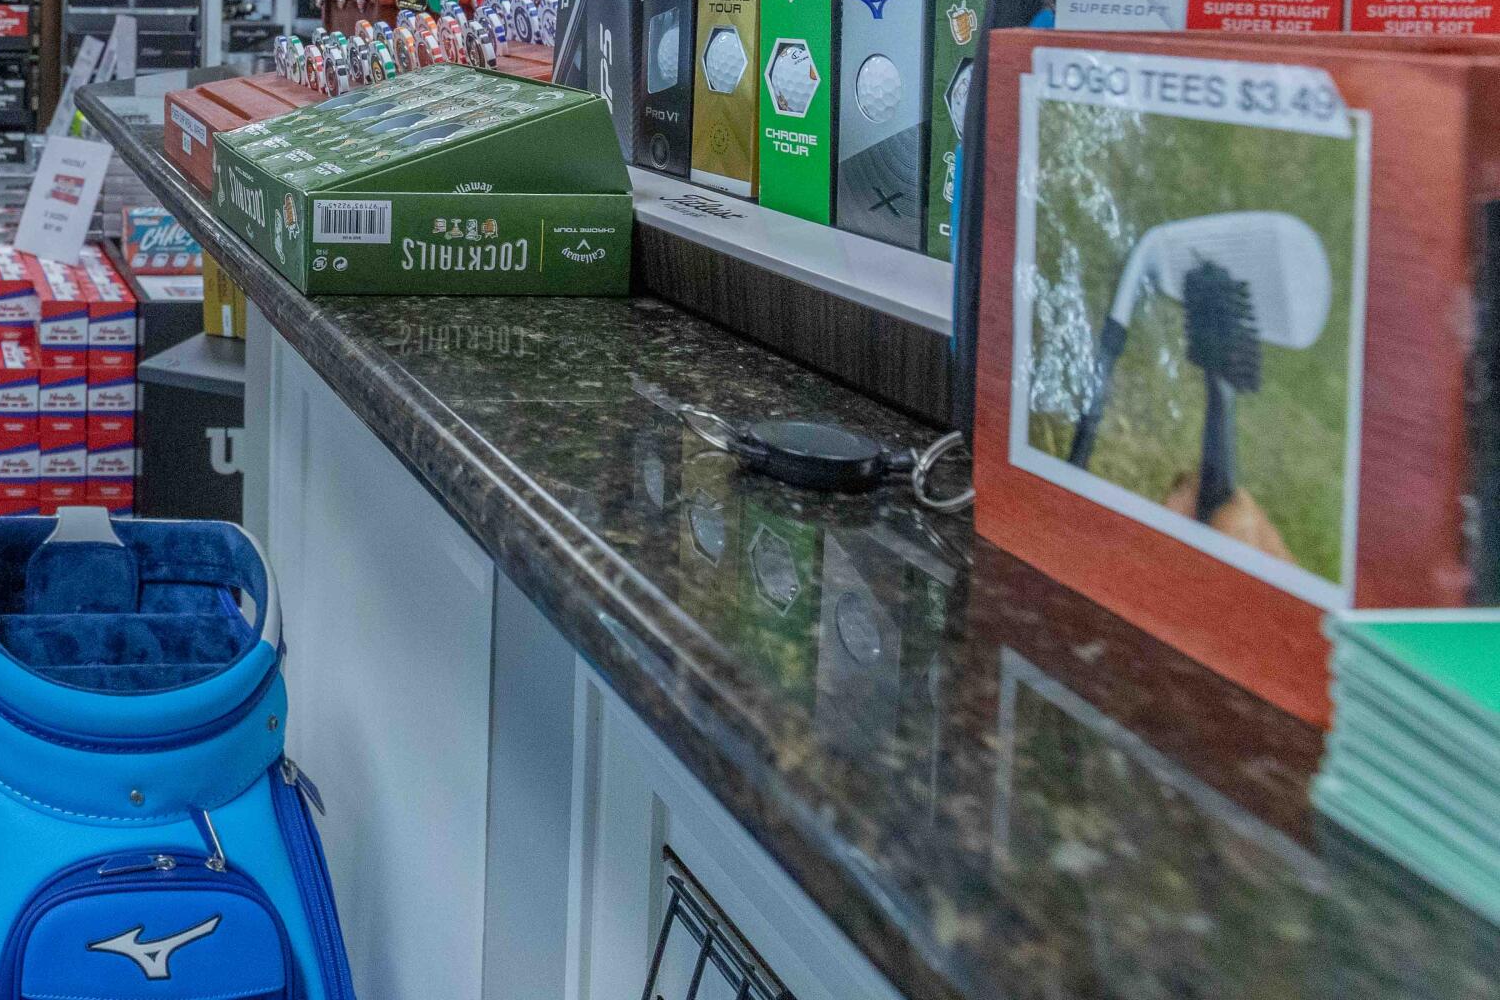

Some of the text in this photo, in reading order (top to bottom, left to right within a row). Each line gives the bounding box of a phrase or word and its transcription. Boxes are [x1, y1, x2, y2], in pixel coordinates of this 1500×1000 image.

[709, 3, 741, 13] TOUR
[1069, 2, 1169, 16] SUPERSOFT
[1203, 2, 1330, 19] SUPER STRAIGHT
[1367, 4, 1492, 19] SUPER STRAIGHT
[1221, 18, 1268, 32] SUPER
[1384, 20, 1432, 34] SUPER
[1046, 62, 1338, 123] LOGO TEES $3.49
[666, 110, 679, 123] V1
[765, 127, 818, 146] CHROME
[773, 141, 809, 157] TOUR
[402, 237, 528, 271] COCKTAILS
[561, 247, 606, 265] Callaway
